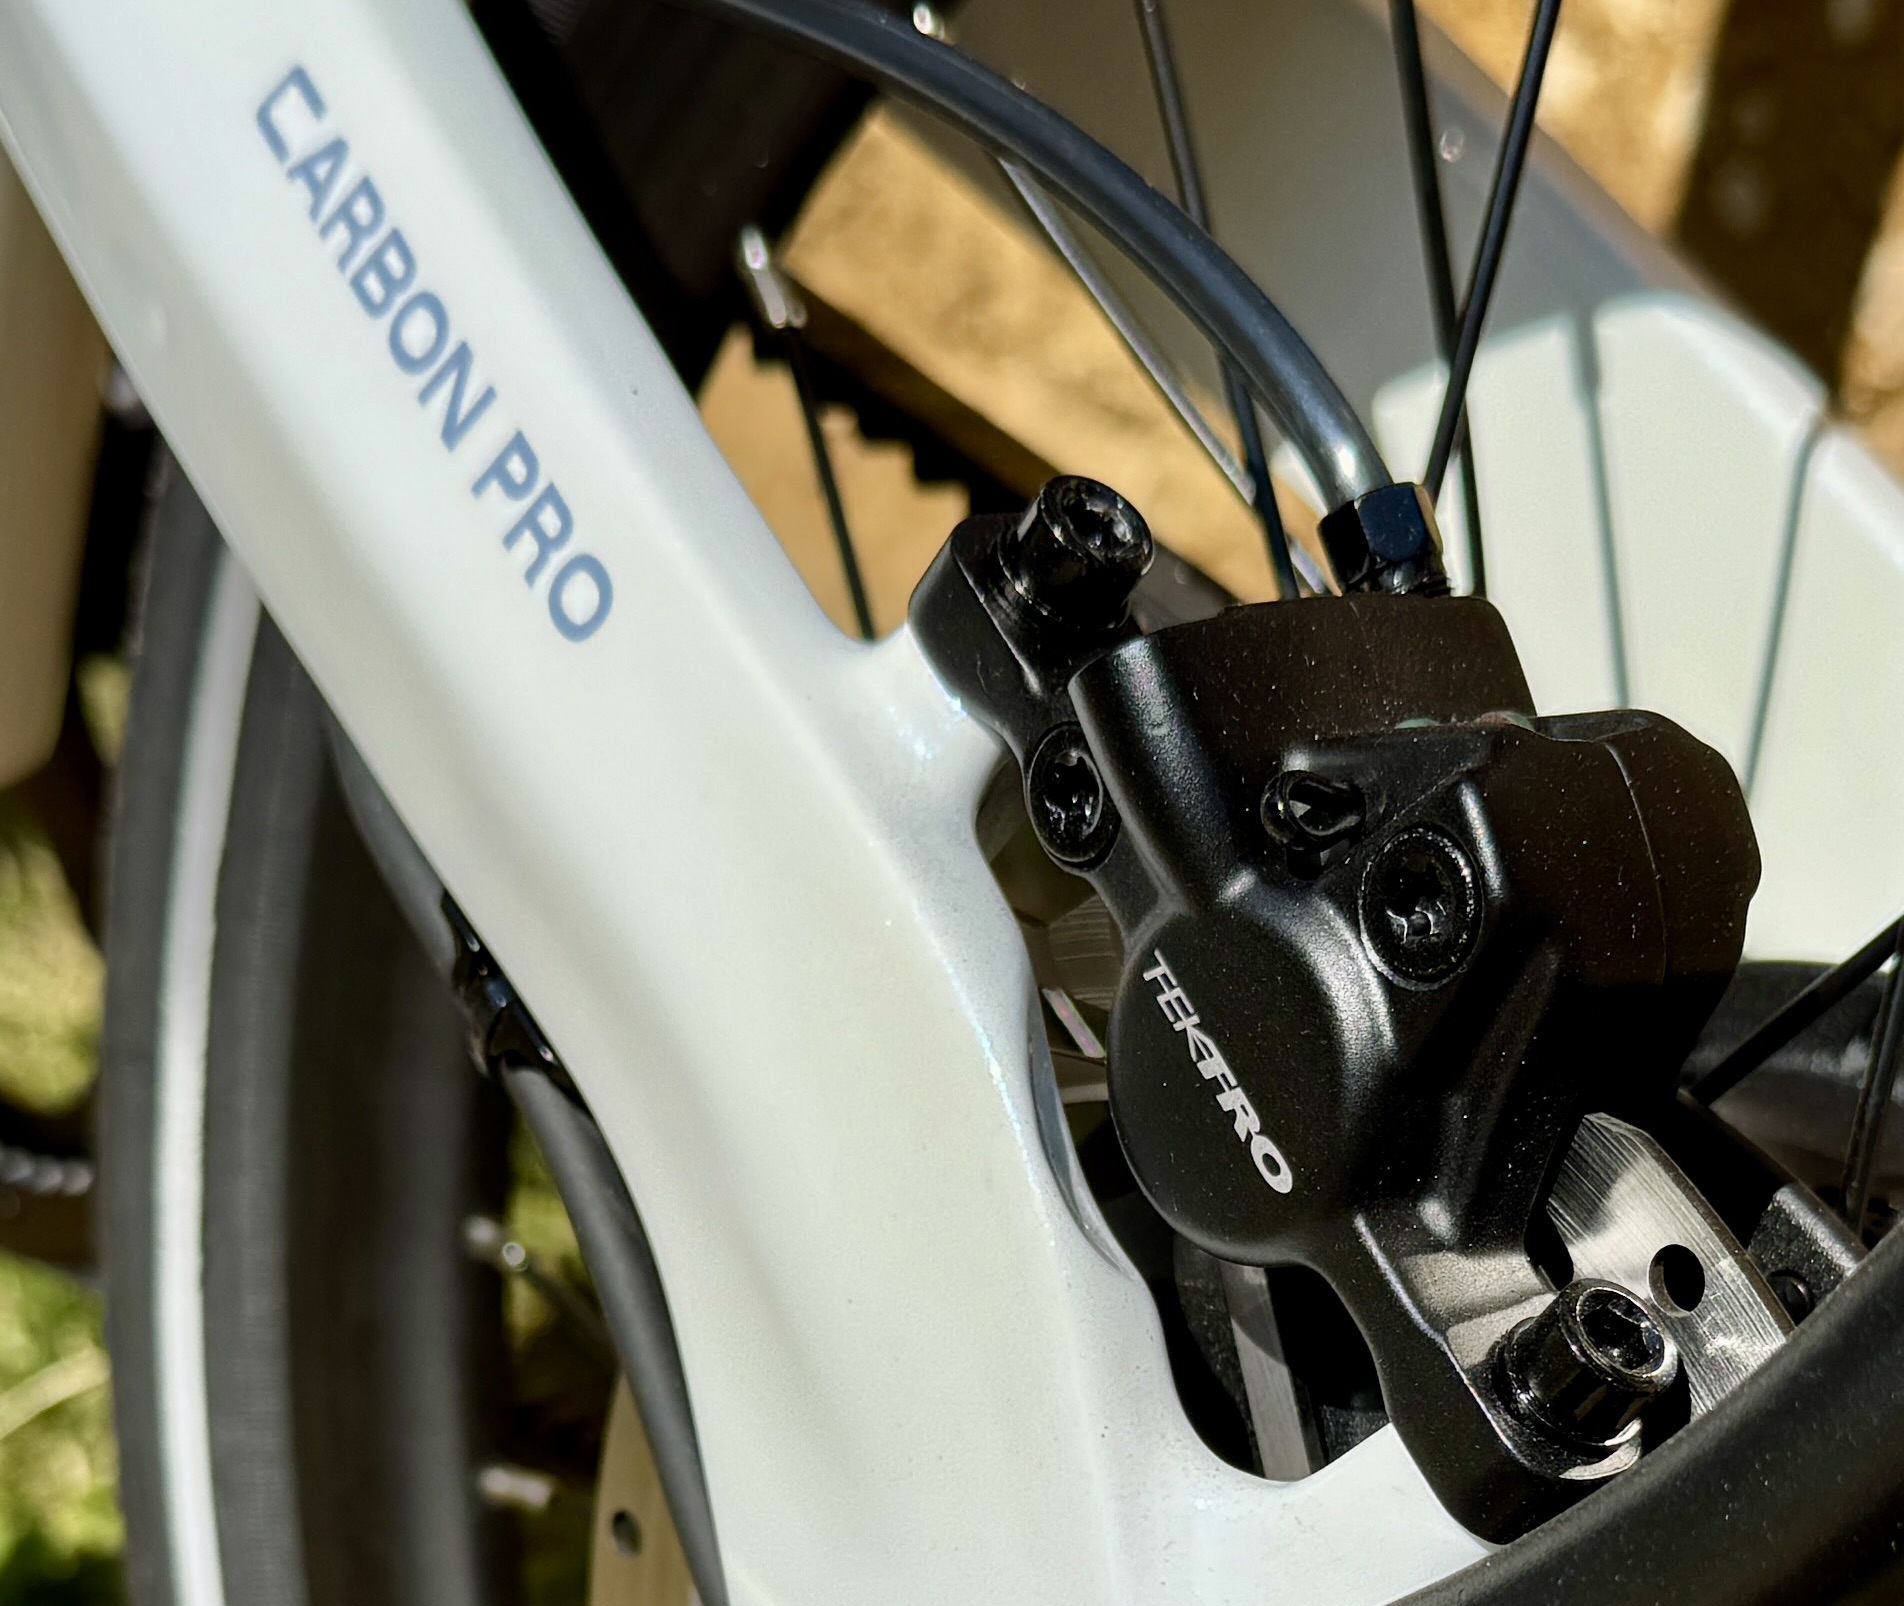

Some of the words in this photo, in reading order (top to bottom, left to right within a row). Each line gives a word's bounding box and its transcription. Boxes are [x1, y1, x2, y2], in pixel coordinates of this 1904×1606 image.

[256, 64, 497, 453] CARBON
[470, 429, 614, 643] PRO
[1142, 948, 1294, 1194] TEKTRO
